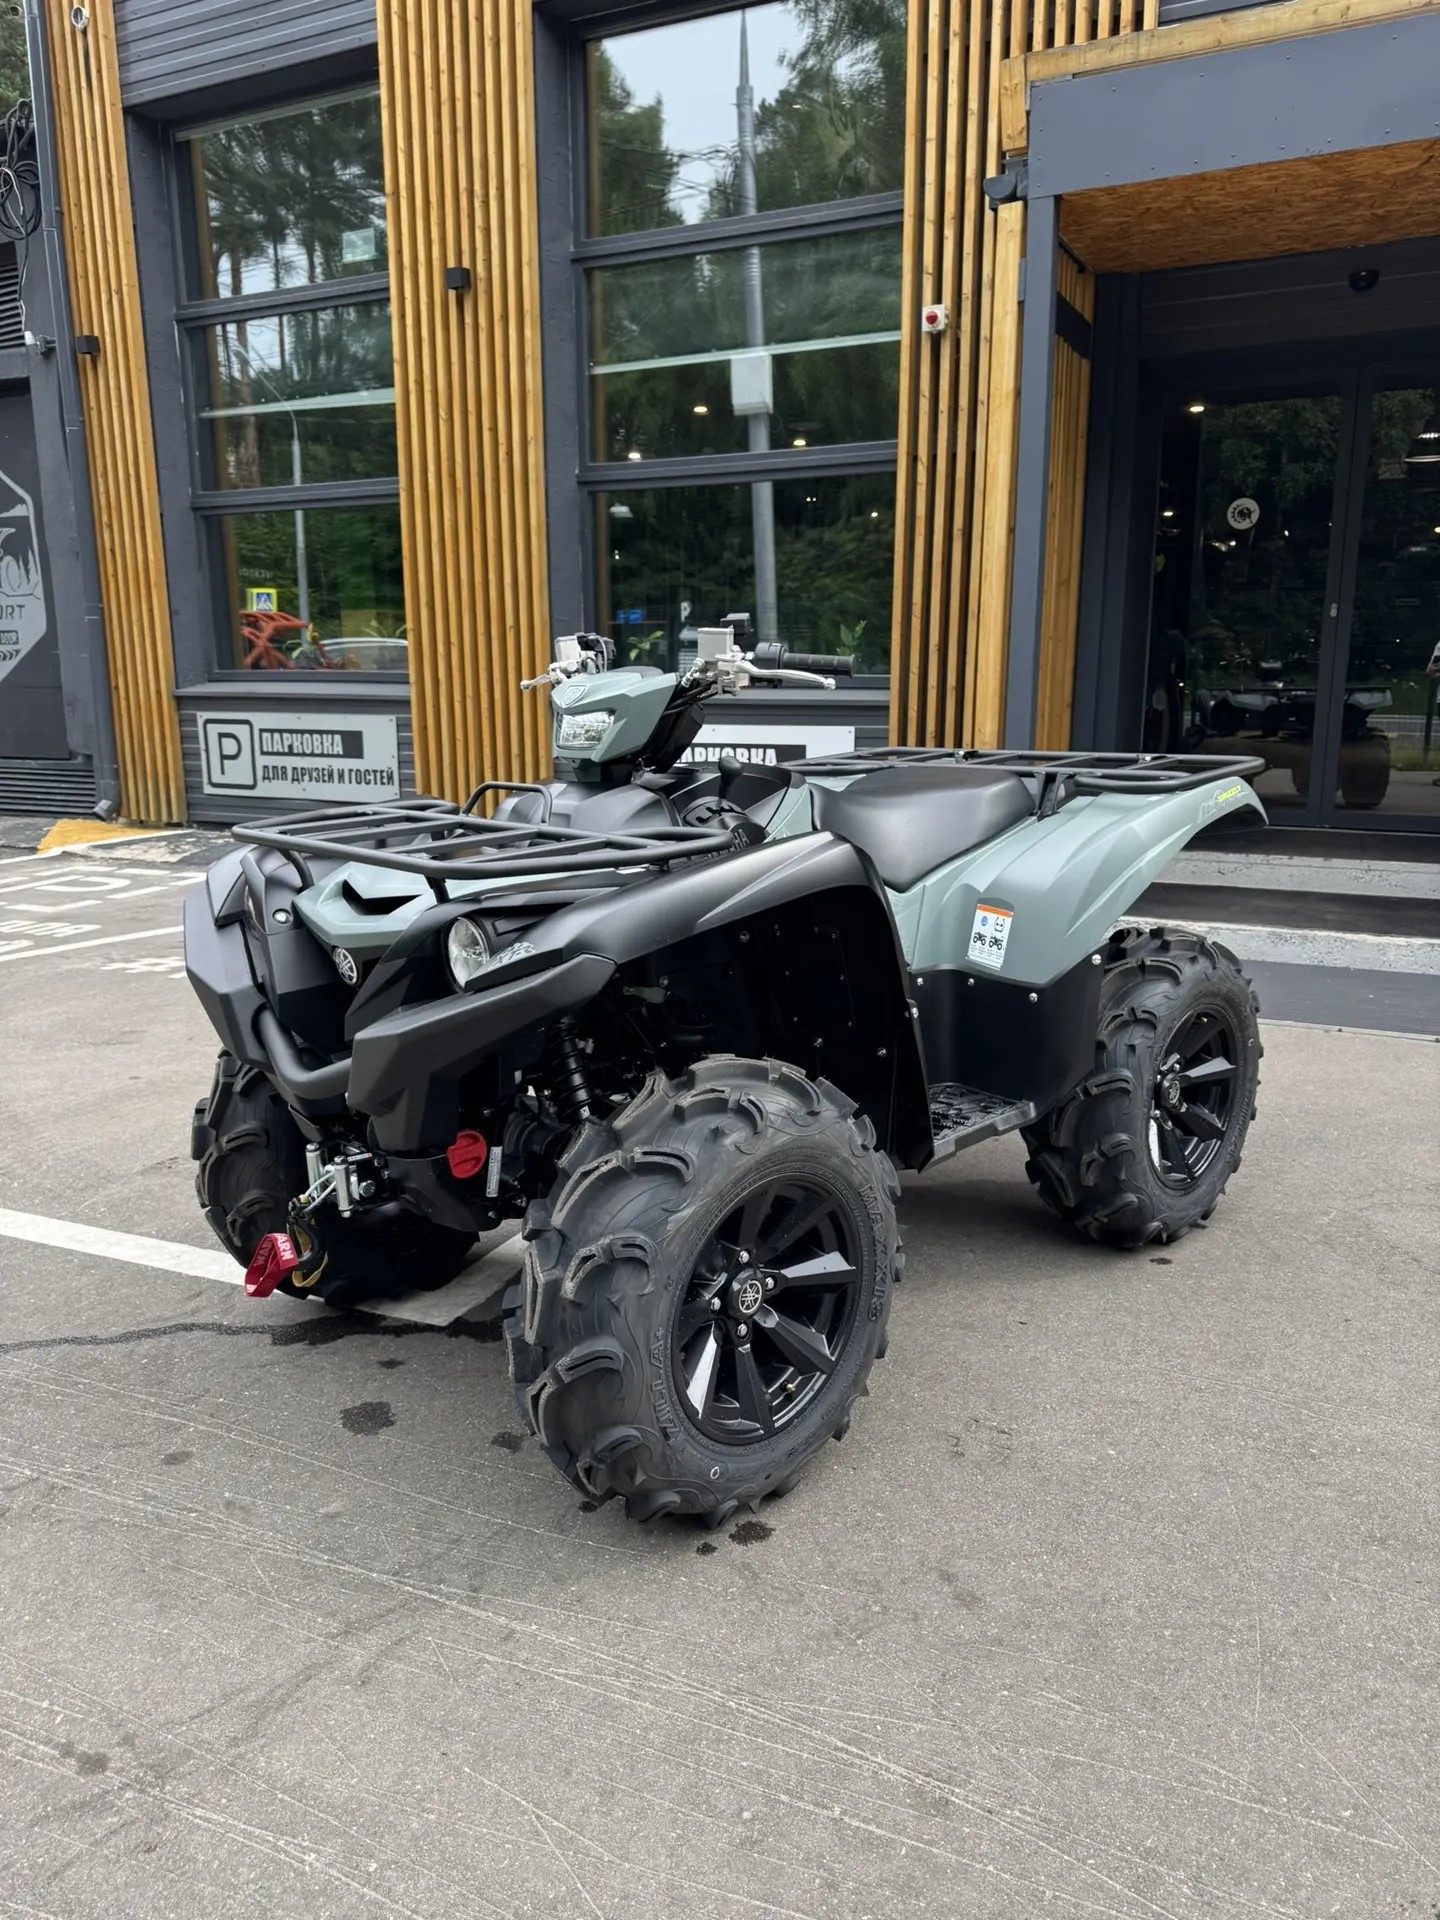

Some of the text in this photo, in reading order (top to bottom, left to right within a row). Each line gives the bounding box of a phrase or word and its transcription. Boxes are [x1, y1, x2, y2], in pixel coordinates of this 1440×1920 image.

[261, 732, 344, 755] ПАРКОВКА
[262, 765, 395, 787] ДЛЯ ДРУЗЕЙ И ГОСТЕЙ
[858, 1183, 887, 1322] MAXXIS
